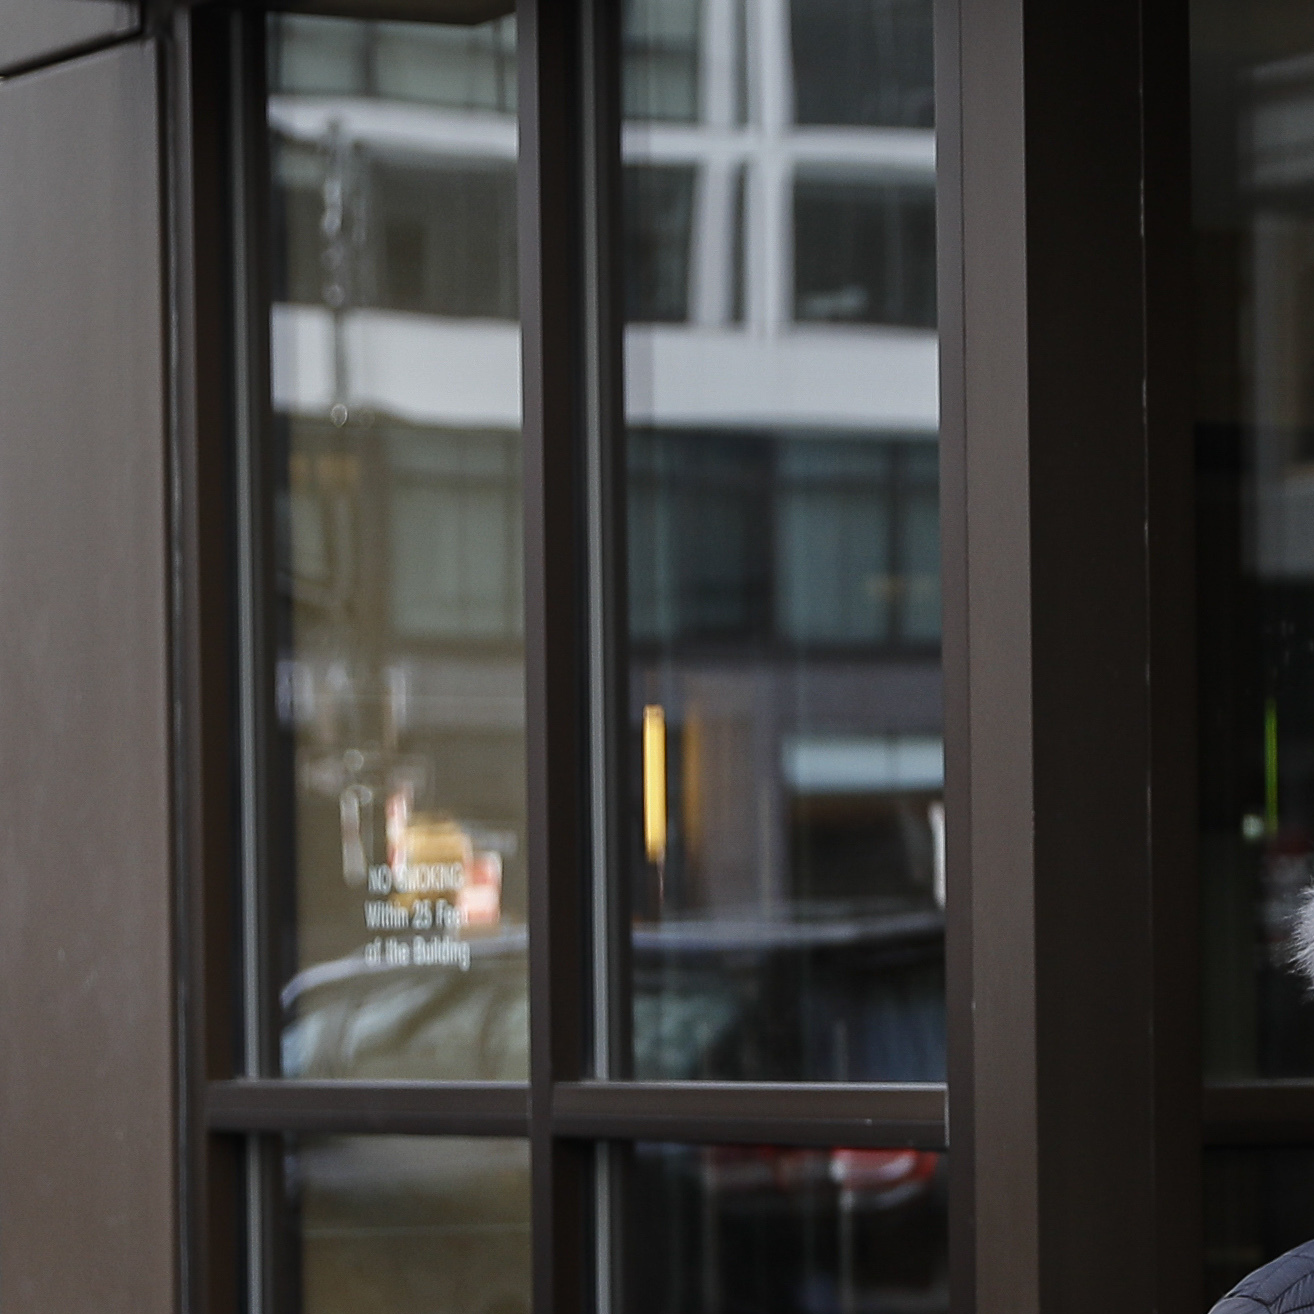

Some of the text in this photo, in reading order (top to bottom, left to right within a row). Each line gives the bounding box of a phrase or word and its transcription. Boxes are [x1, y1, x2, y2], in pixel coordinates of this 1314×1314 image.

[368, 864, 391, 894] NO
[364, 900, 409, 928] Within
[412, 899, 432, 929] 25
[414, 936, 470, 971] Building
